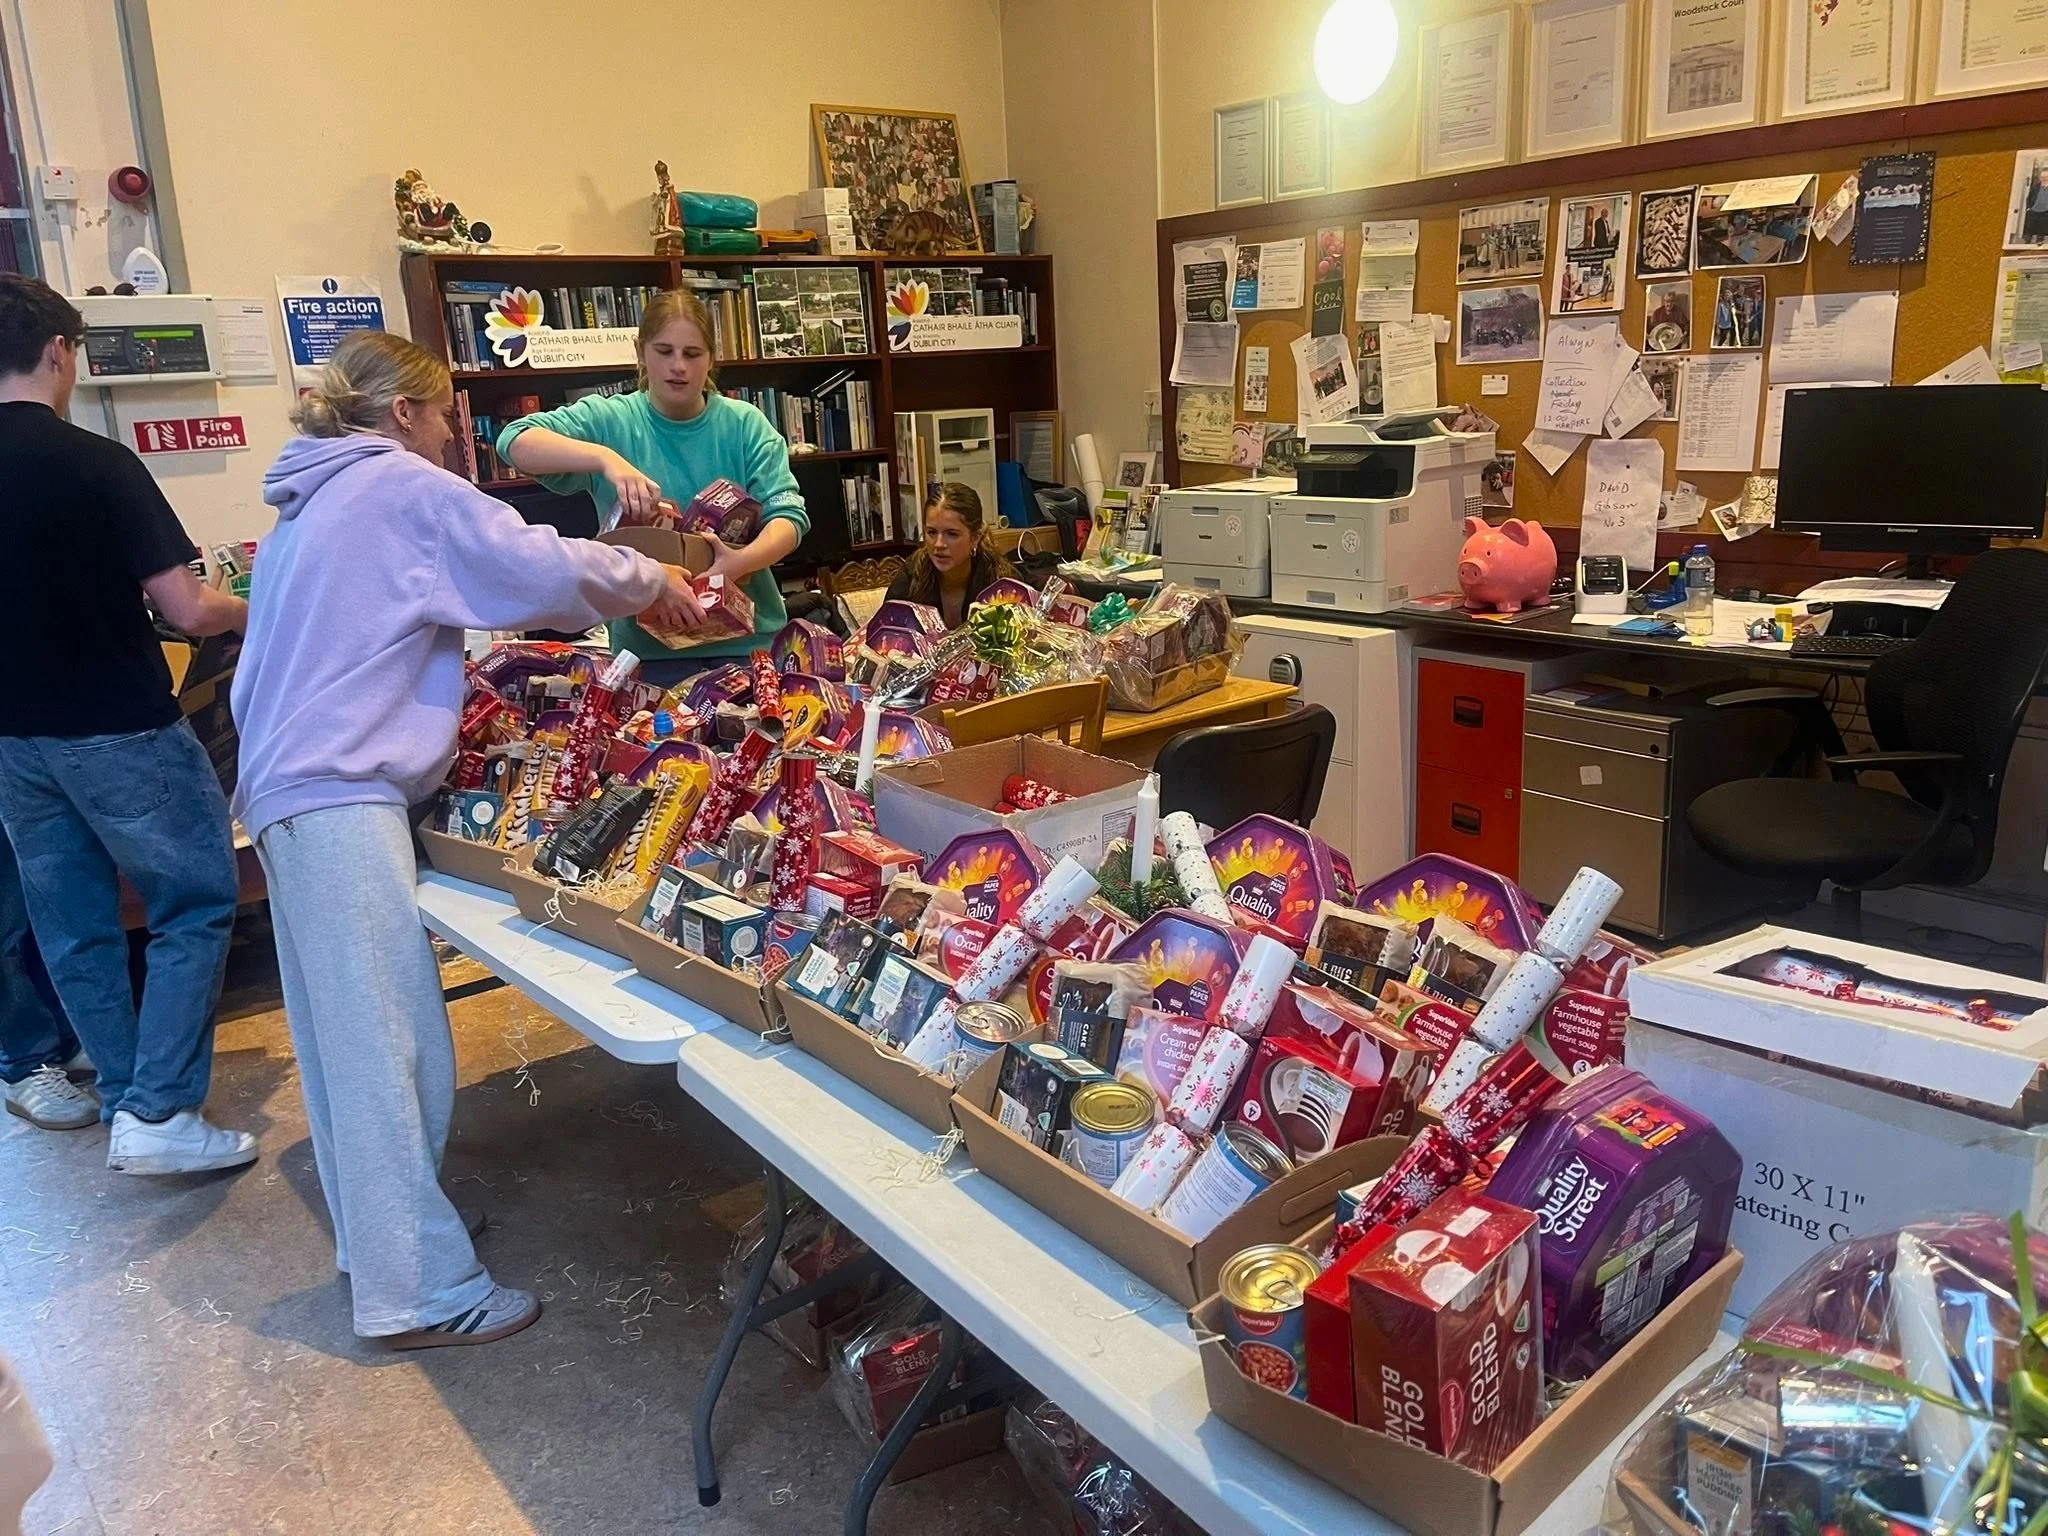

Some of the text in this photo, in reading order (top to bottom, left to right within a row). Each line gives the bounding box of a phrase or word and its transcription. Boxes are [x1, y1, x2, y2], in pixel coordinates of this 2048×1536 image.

[1674, 2, 1720, 18] Woodstock
[287, 299, 378, 313] Fire action
[913, 322, 946, 333] CATHAIR
[947, 322, 973, 331] BHAILE
[995, 321, 1018, 329] CLIATH
[529, 335, 570, 346] CATHAIR
[572, 334, 603, 345] BHAILE
[940, 339, 957, 347] CITY
[566, 353, 586, 362] CITY
[1545, 376, 1587, 387] Collection
[1551, 398, 1582, 411] Friday
[200, 420, 232, 433] Fire
[196, 433, 241, 447] Point
[1594, 498, 1638, 511] Gibson
[1618, 516, 1625, 527] 3
[503, 742, 547, 850] Kimberley
[646, 814, 684, 875] Kimberley
[984, 881, 1000, 890] PAPER
[1270, 880, 1286, 892] PAPER
[1231, 885, 1276, 919] Quality
[954, 934, 983, 953] Oxtail
[1190, 989, 1209, 1001] PAPER
[1568, 1000, 1605, 1016] SuperValu
[1553, 1007, 1602, 1029] Farmhouse
[1080, 1023, 1090, 1048] CAKE
[1413, 1014, 1453, 1040] Farmhouse
[1558, 1021, 1600, 1039] vegetable
[1160, 1033, 1200, 1050] Cream of
[1415, 1028, 1449, 1049] vegetable
[1552, 1031, 1598, 1052] instant soup
[1164, 1047, 1195, 1061] chicken
[1157, 1060, 1177, 1071] instant
[1579, 1061, 1587, 1072] 3
[1248, 1106, 1256, 1118] 4
[1754, 1162, 1784, 1190] 30
[1791, 1173, 1815, 1202] X
[1535, 1156, 1589, 1234] Quality
[1554, 1177, 1609, 1243] Street
[1735, 1194, 1821, 1241] atering
[896, 1349, 926, 1366] GOLD
[896, 1356, 930, 1375] BLEND
[1483, 1322, 1500, 1418] BLEND
[1470, 1341, 1485, 1425] GOLD
[1705, 1462, 1733, 1480] IRISH
[1696, 1467, 1743, 1495] MATURED
[1697, 1477, 1742, 1503] PUDDING
